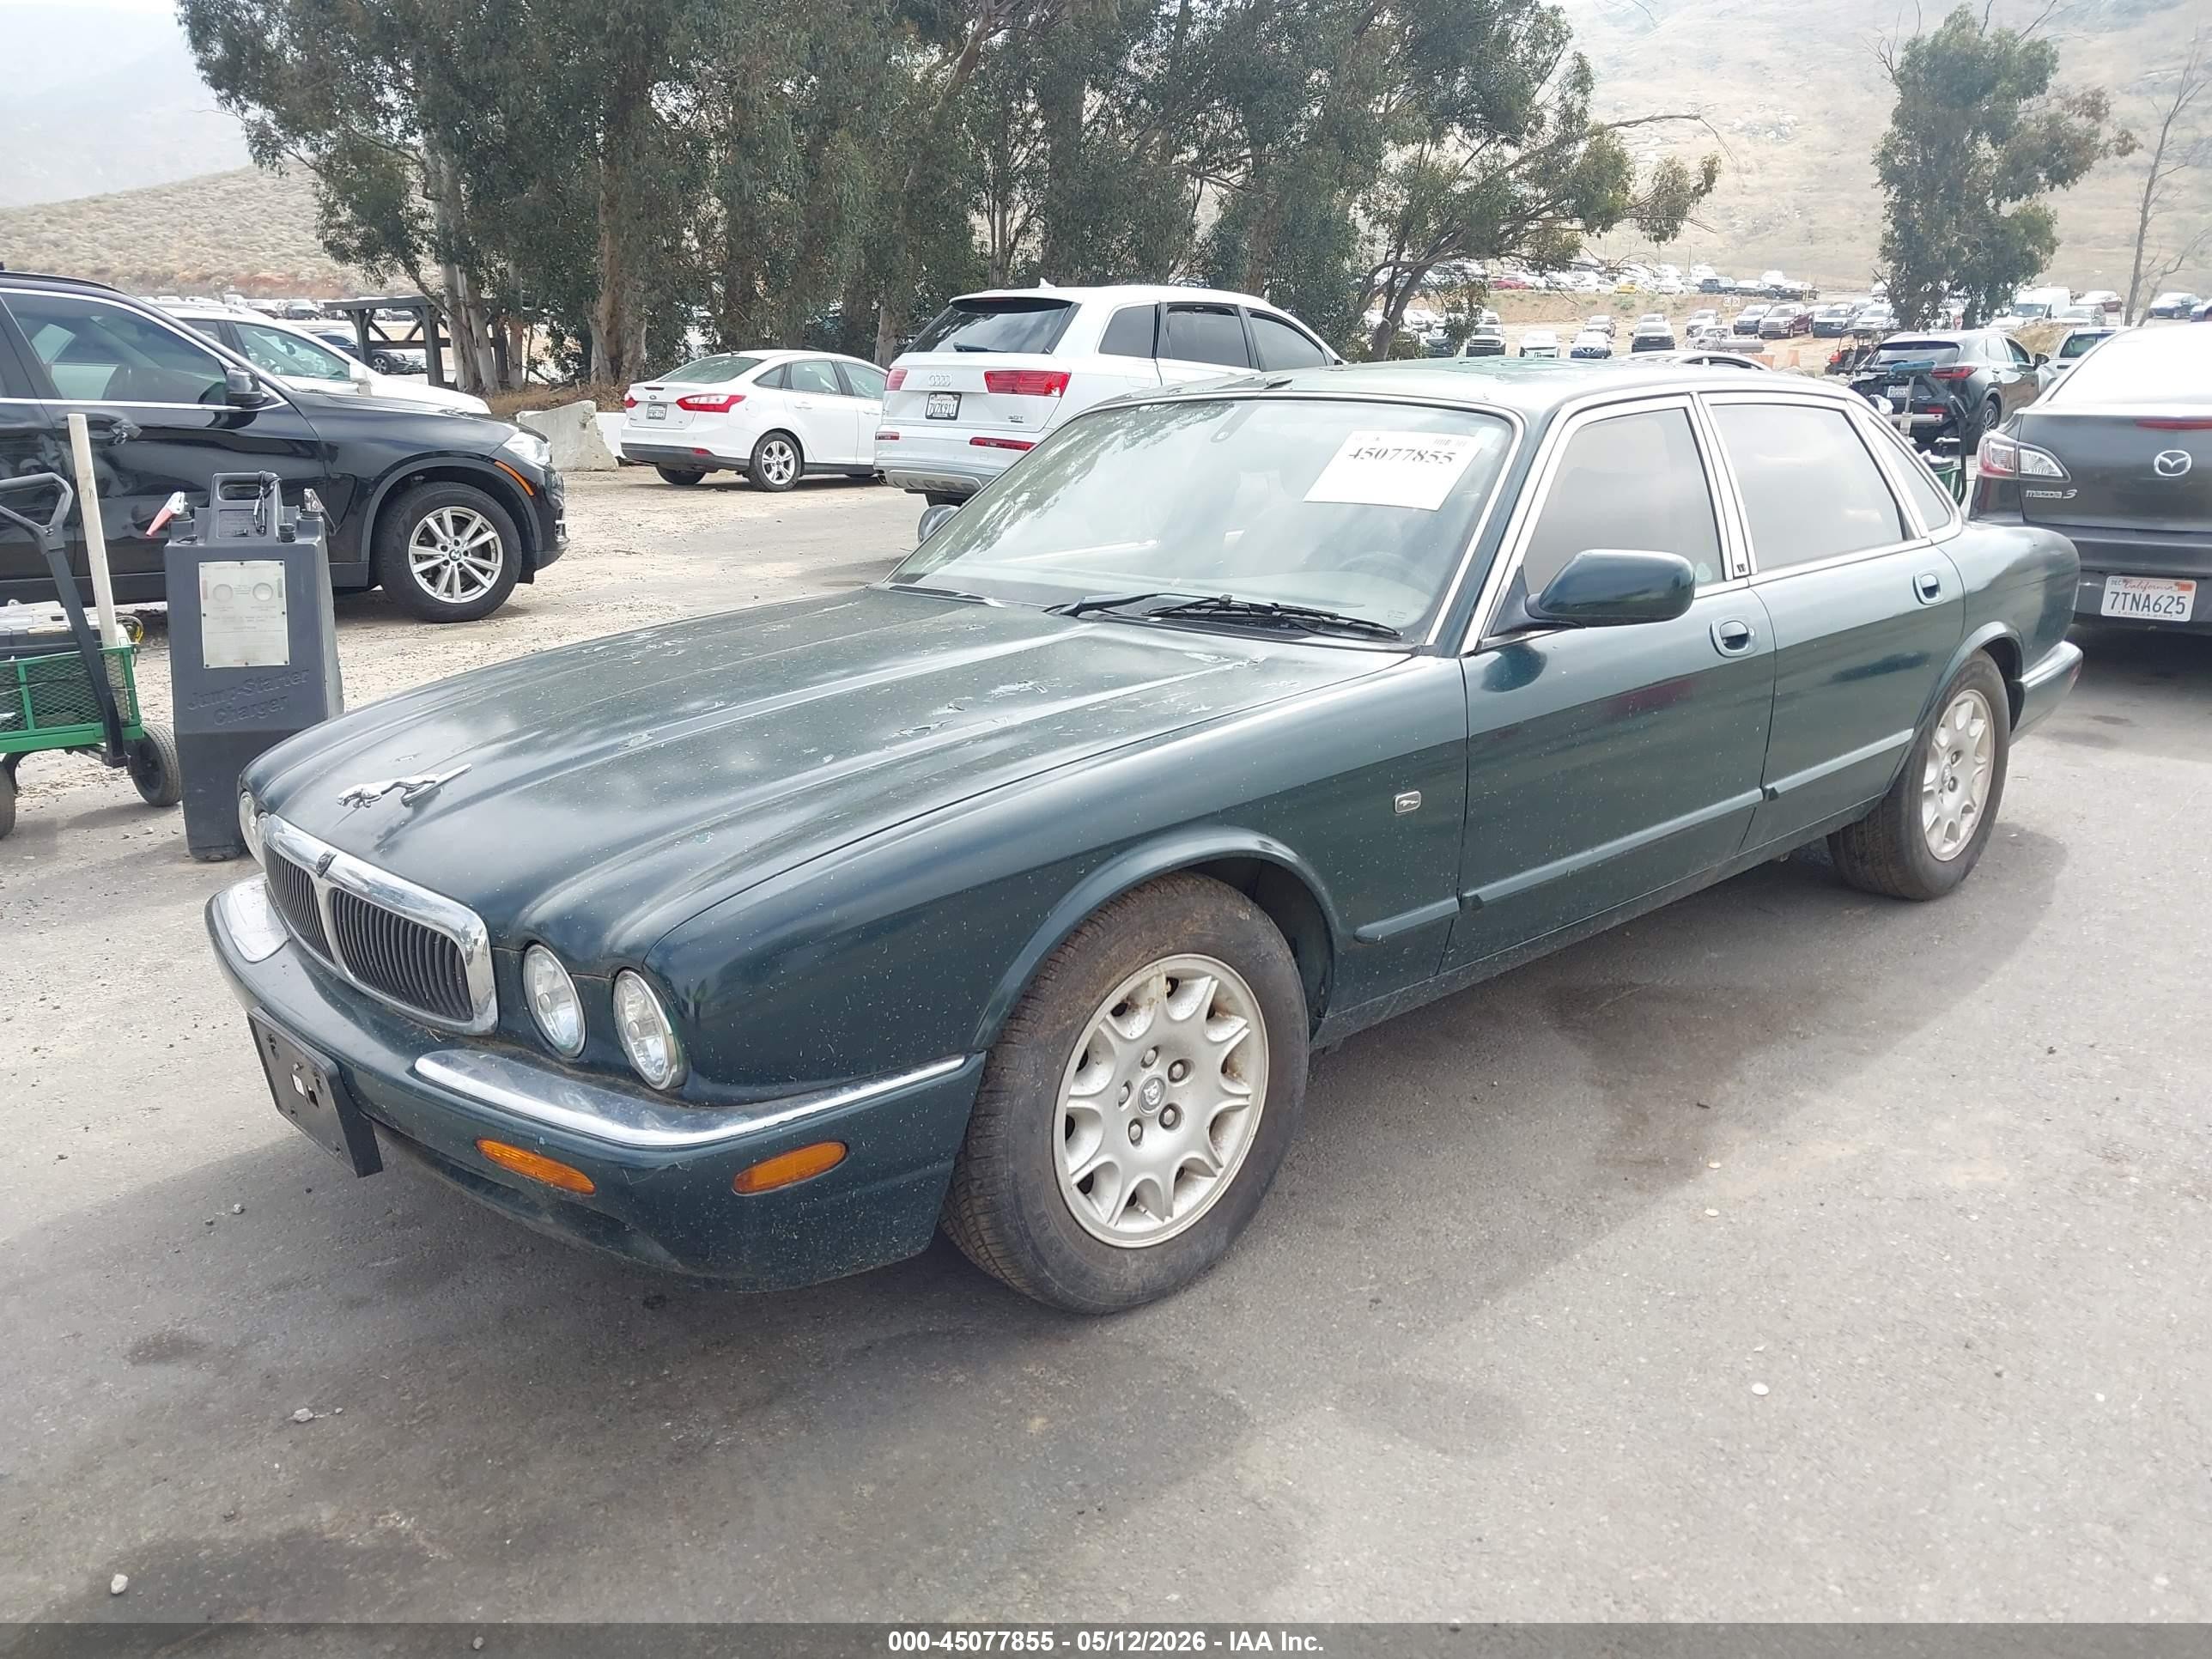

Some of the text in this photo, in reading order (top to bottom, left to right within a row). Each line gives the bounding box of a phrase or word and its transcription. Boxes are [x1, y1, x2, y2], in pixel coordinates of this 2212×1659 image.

[1348, 447, 1456, 464] 45077855
[2124, 580, 2172, 592] California
[2110, 592, 2186, 615] 7TNA625
[215, 696, 288, 726] Charger
